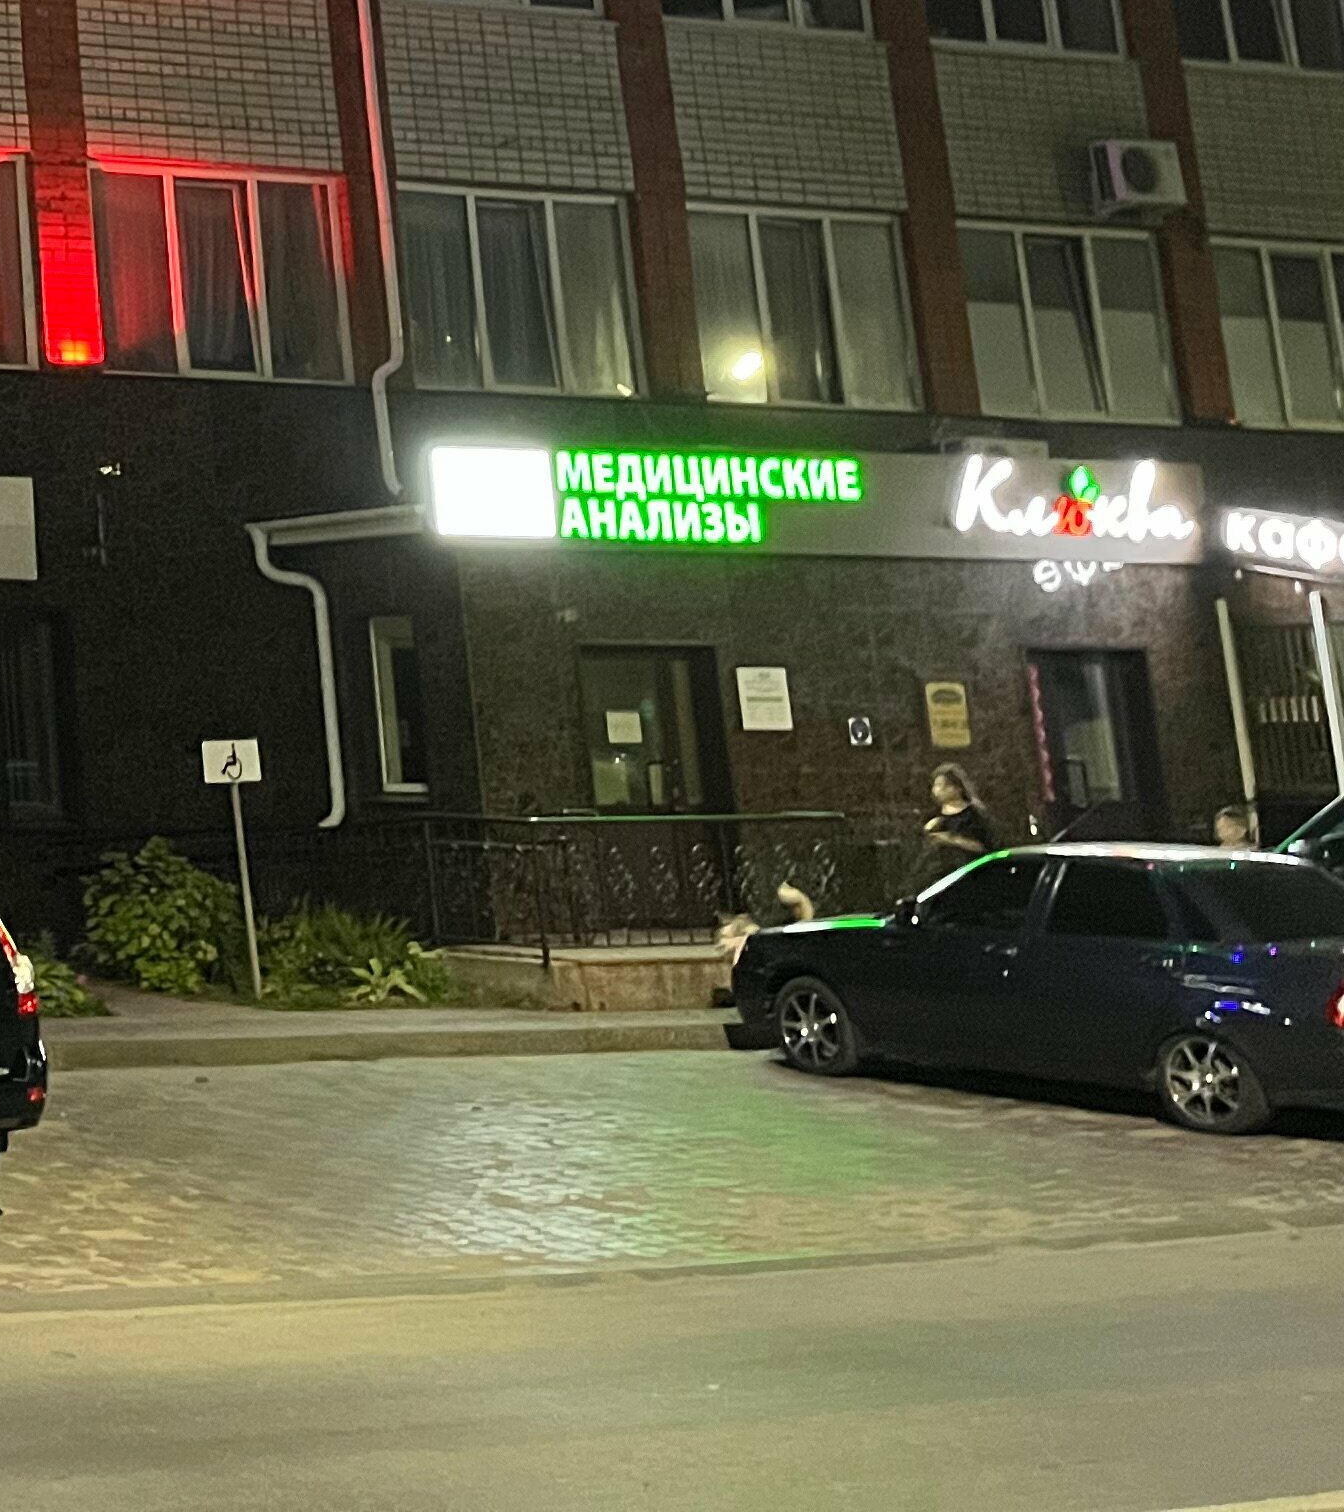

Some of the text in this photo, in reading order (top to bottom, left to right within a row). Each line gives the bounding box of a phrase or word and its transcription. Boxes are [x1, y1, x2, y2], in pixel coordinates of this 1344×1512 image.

[556, 450, 861, 502] МЕДИЦИНСКИЕ
[955, 452, 1196, 542] Клюква
[561, 498, 761, 542] АНАЛИЗЫ
